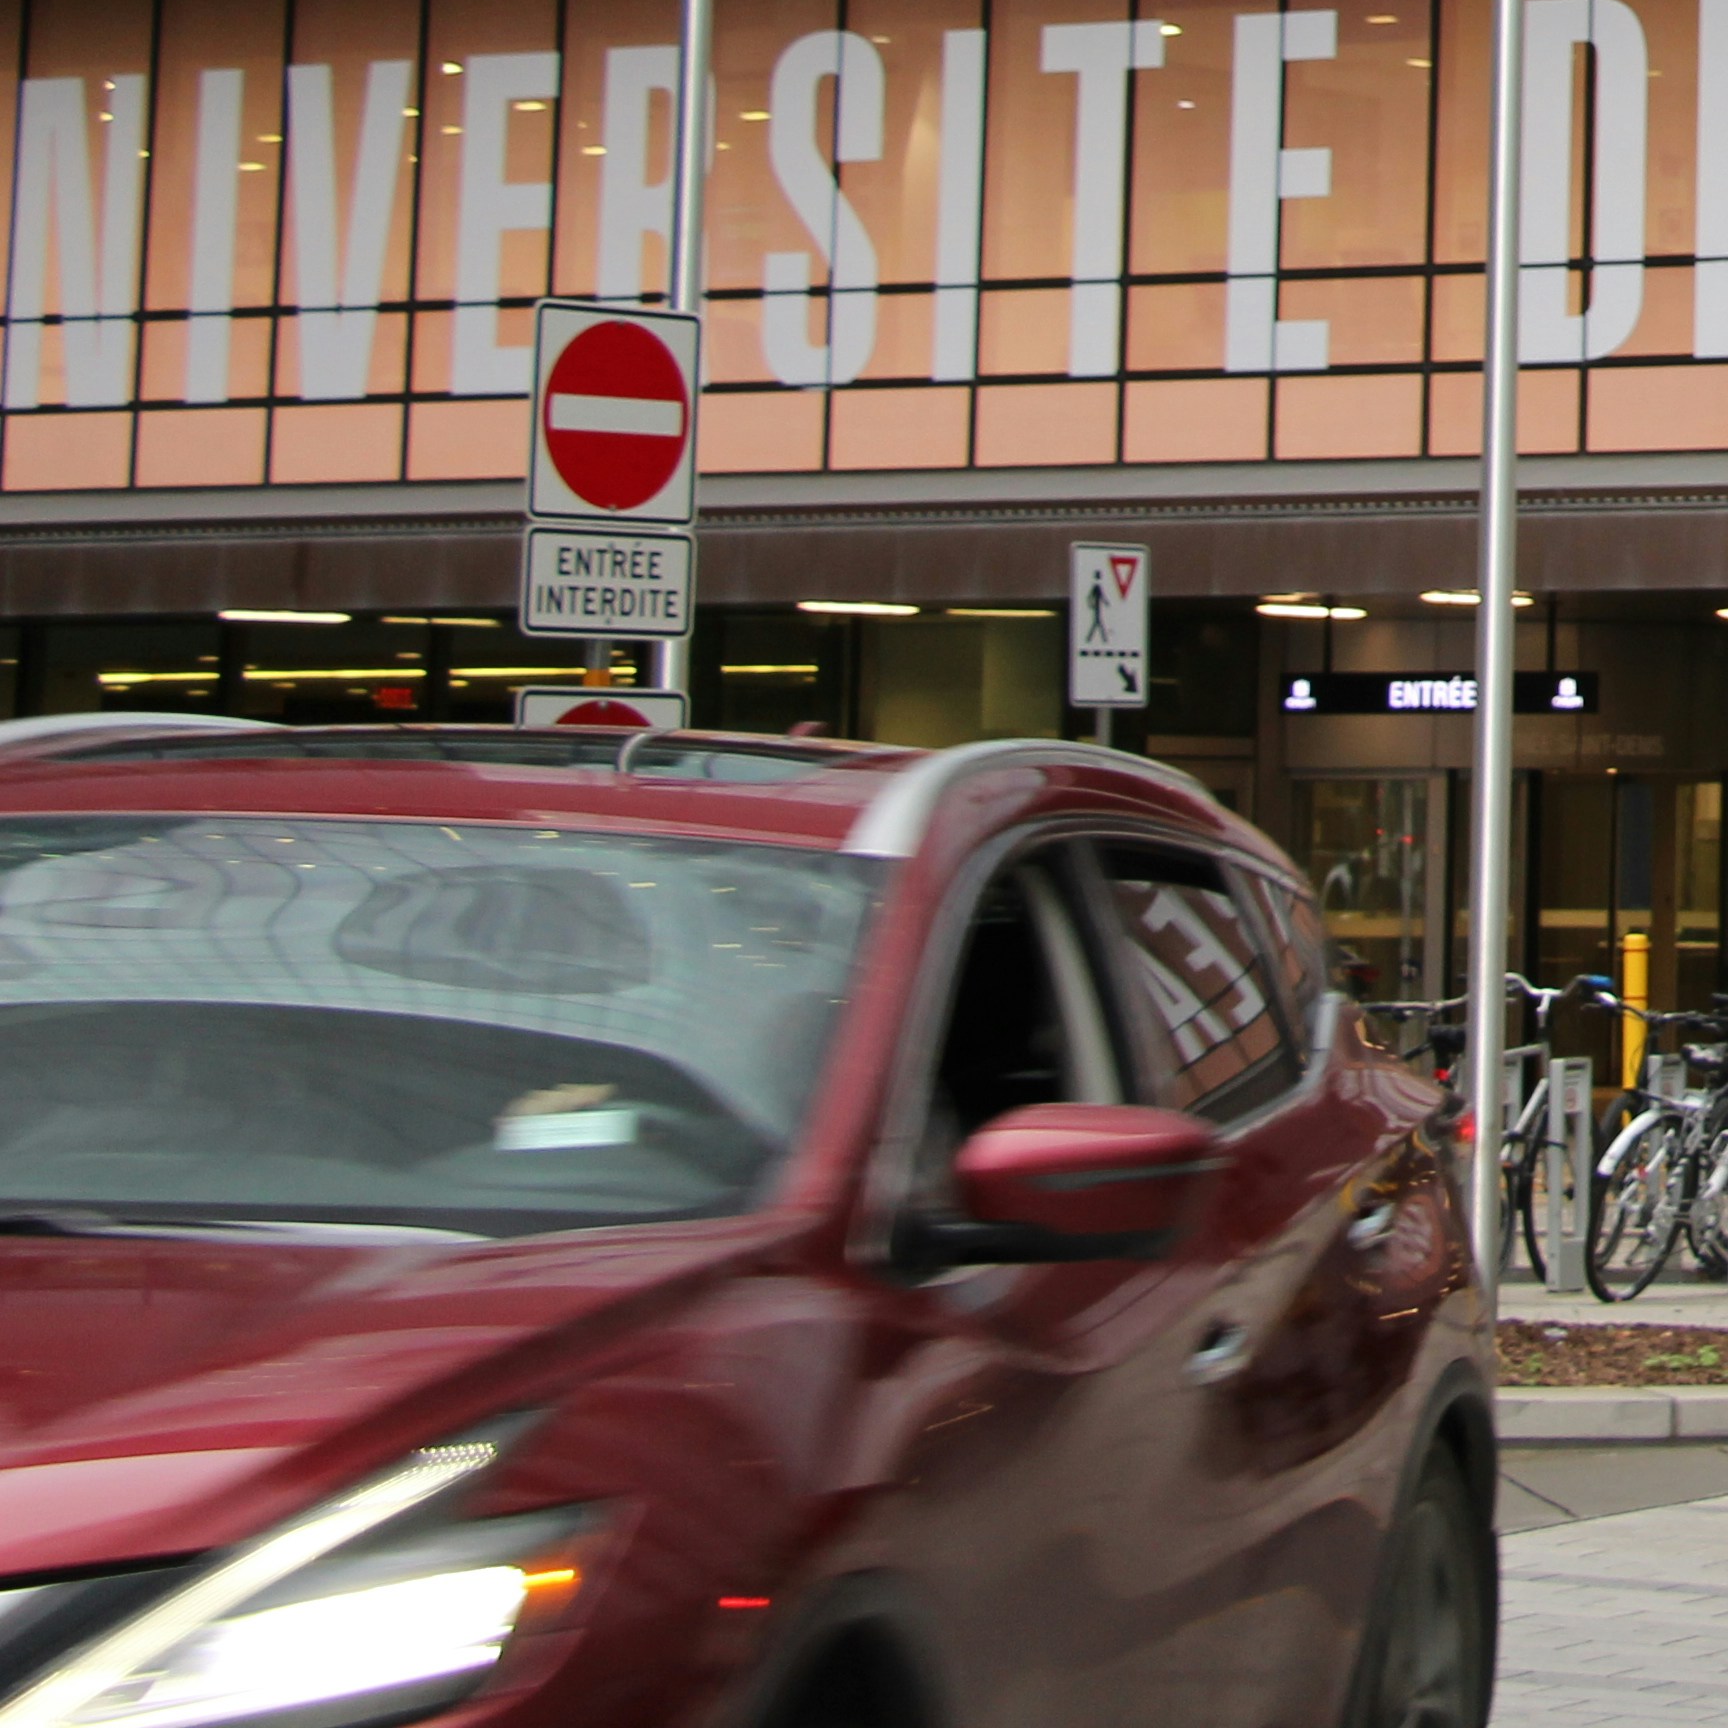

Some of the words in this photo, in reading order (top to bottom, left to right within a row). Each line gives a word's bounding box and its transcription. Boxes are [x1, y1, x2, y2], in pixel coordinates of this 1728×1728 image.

[558, 541, 662, 579] ENTRÉE
[536, 584, 679, 618] INTERDITE
[1388, 675, 1477, 709] ENTRÉE
